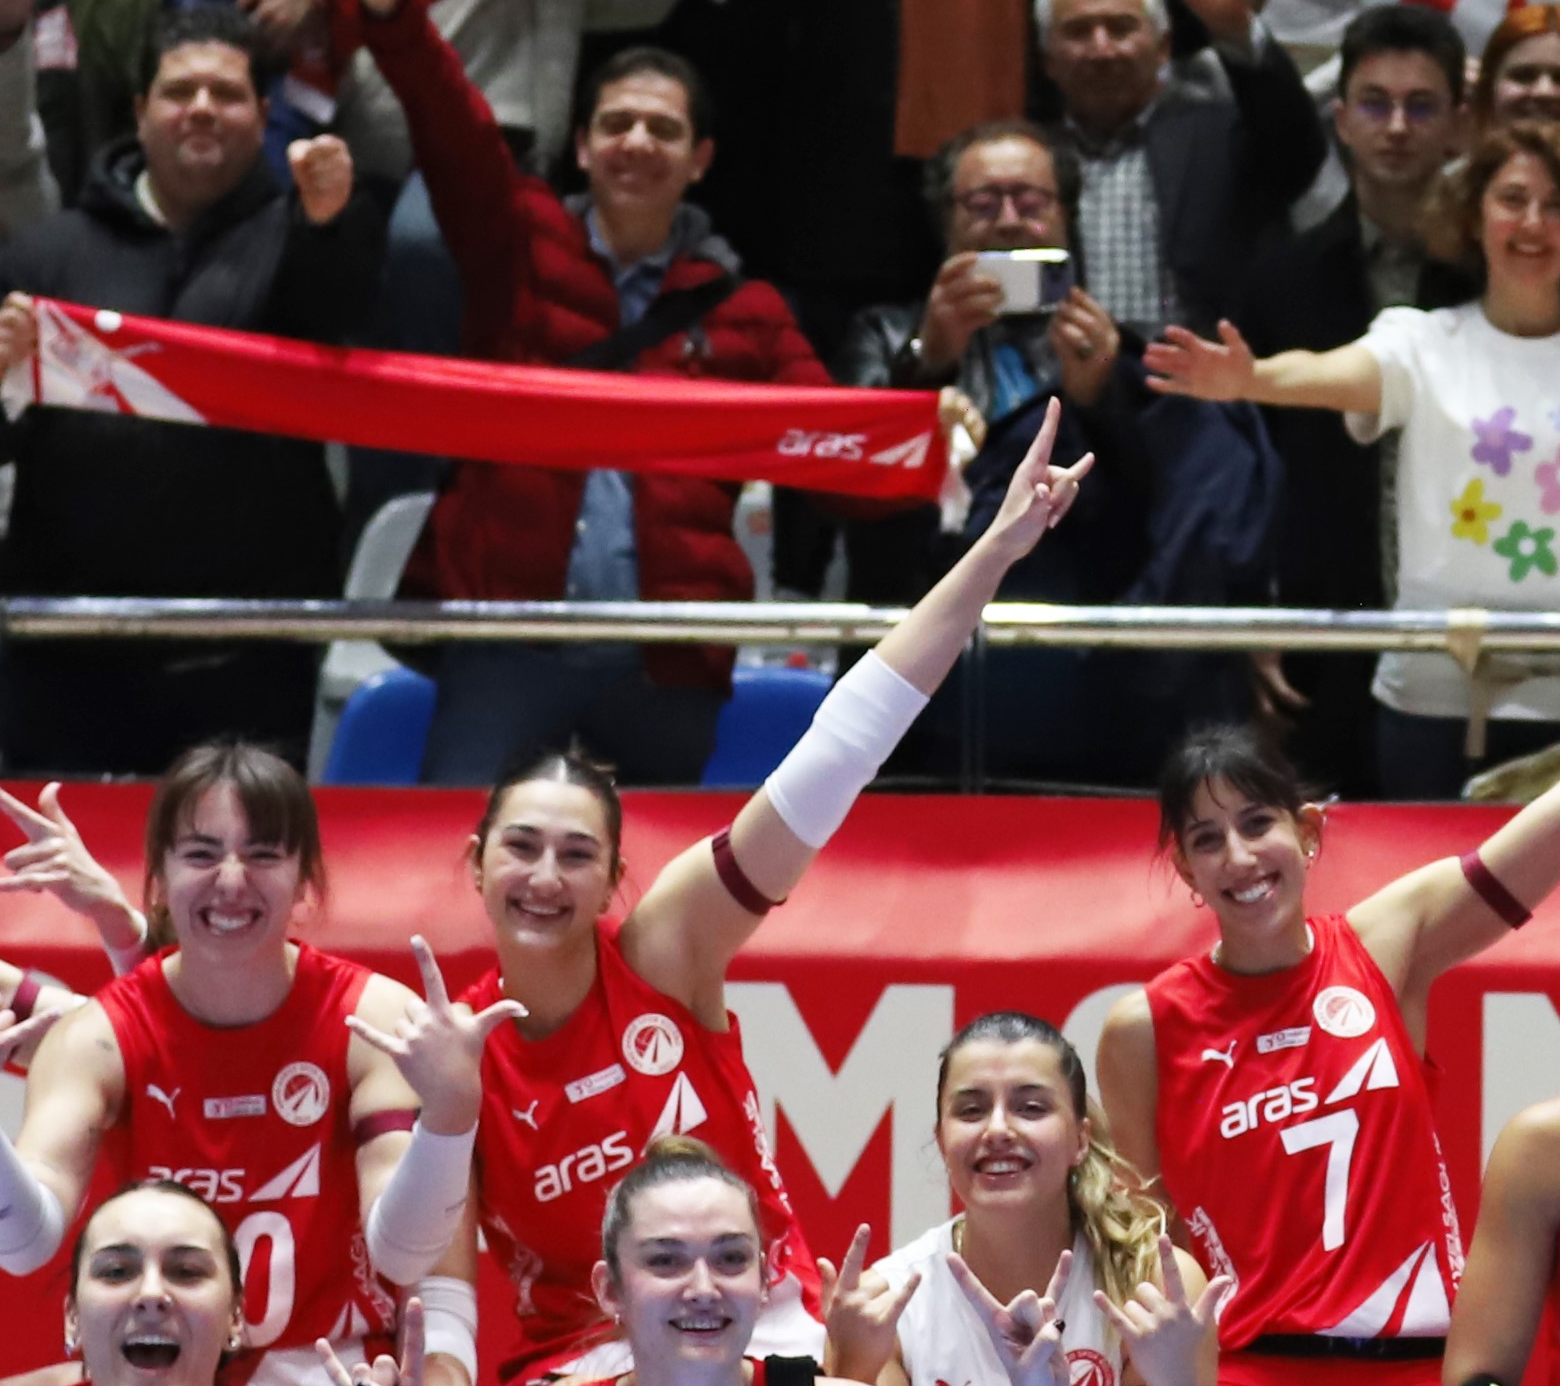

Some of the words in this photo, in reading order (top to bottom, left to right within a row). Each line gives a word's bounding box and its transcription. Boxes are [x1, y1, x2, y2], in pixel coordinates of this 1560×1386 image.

[777, 429, 869, 462] aras
[1220, 1076, 1320, 1139] aras
[535, 1130, 634, 1202] aras
[1279, 1108, 1360, 1252] 7
[234, 1211, 296, 1349] 0
